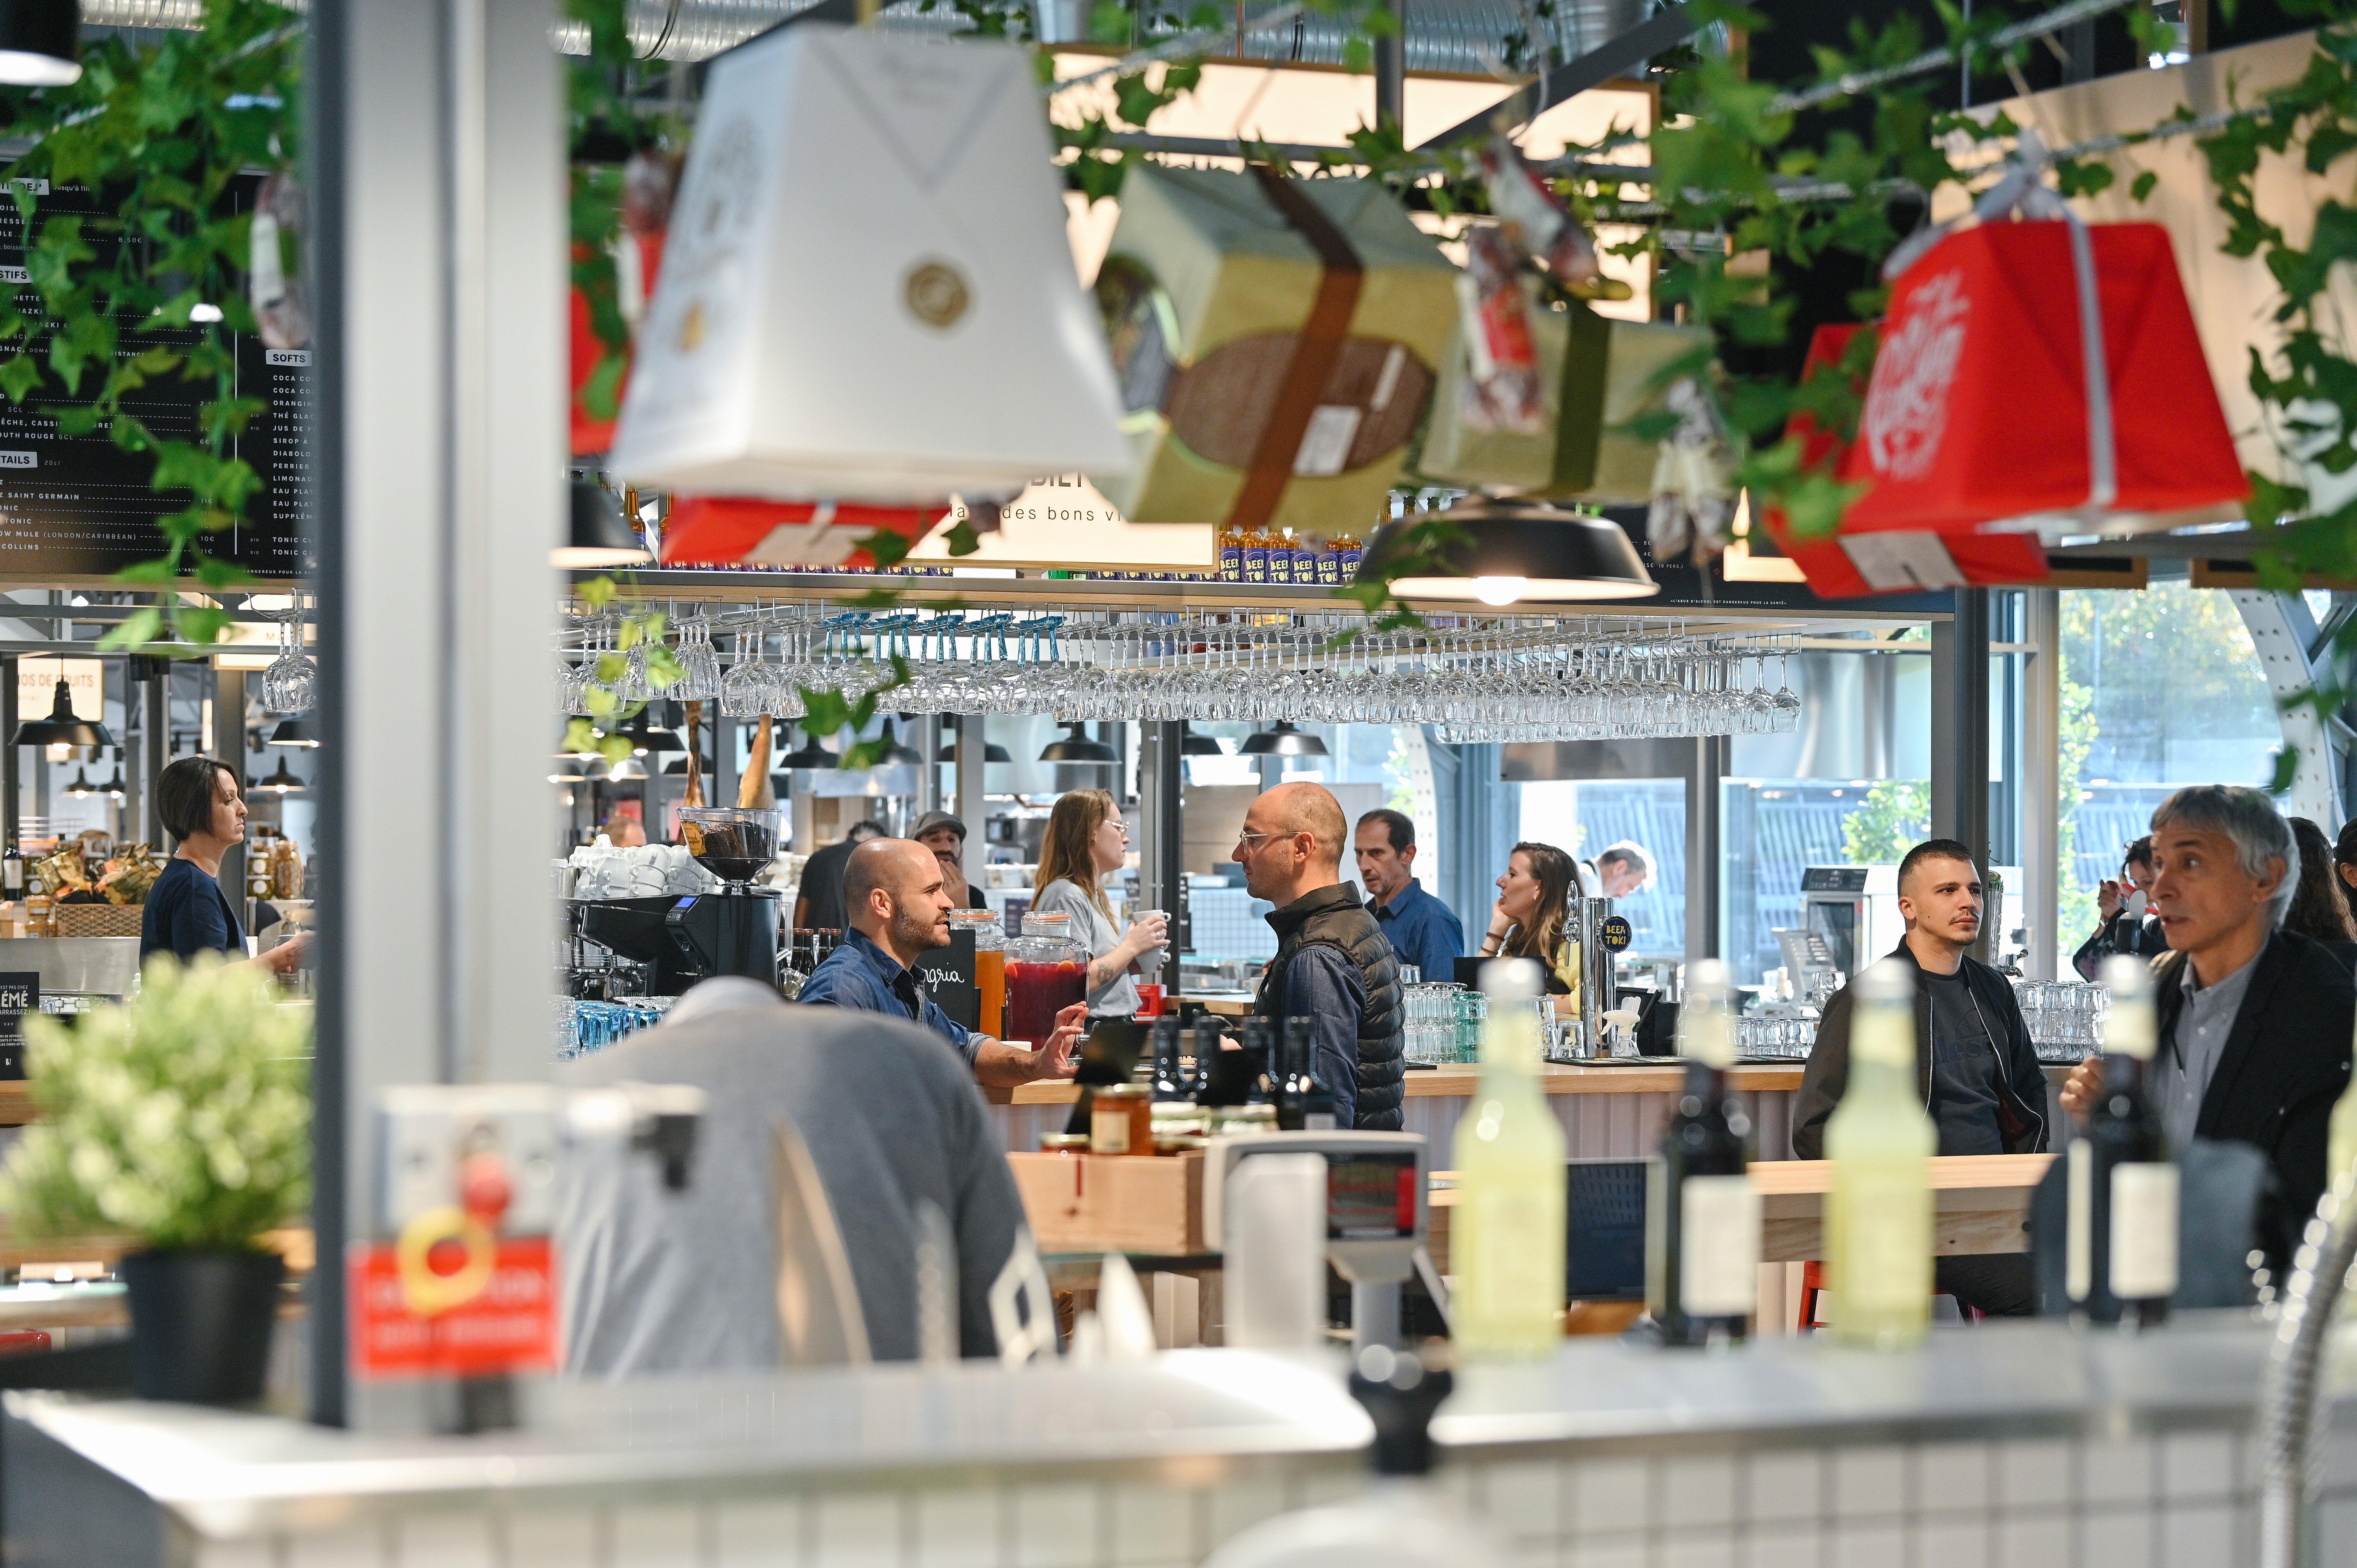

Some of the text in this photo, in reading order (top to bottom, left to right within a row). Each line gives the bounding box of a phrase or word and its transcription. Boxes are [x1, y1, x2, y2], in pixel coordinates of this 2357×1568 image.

[273, 353, 306, 363] SOFTS
[1002, 505, 1036, 520] des
[1048, 506, 1094, 521] bons
[44, 532, 136, 540] (LONDON/CARIBBEAN)
[1220, 558, 1239, 570] BEER
[1246, 559, 1264, 570] BEER
[1270, 560, 1289, 571] BEER
[1293, 560, 1313, 571] BEER
[1317, 561, 1337, 572] BEER
[1318, 572, 1338, 583] TOKI
[1606, 925, 1626, 934] BEER
[1605, 936, 1626, 945] TOKI
